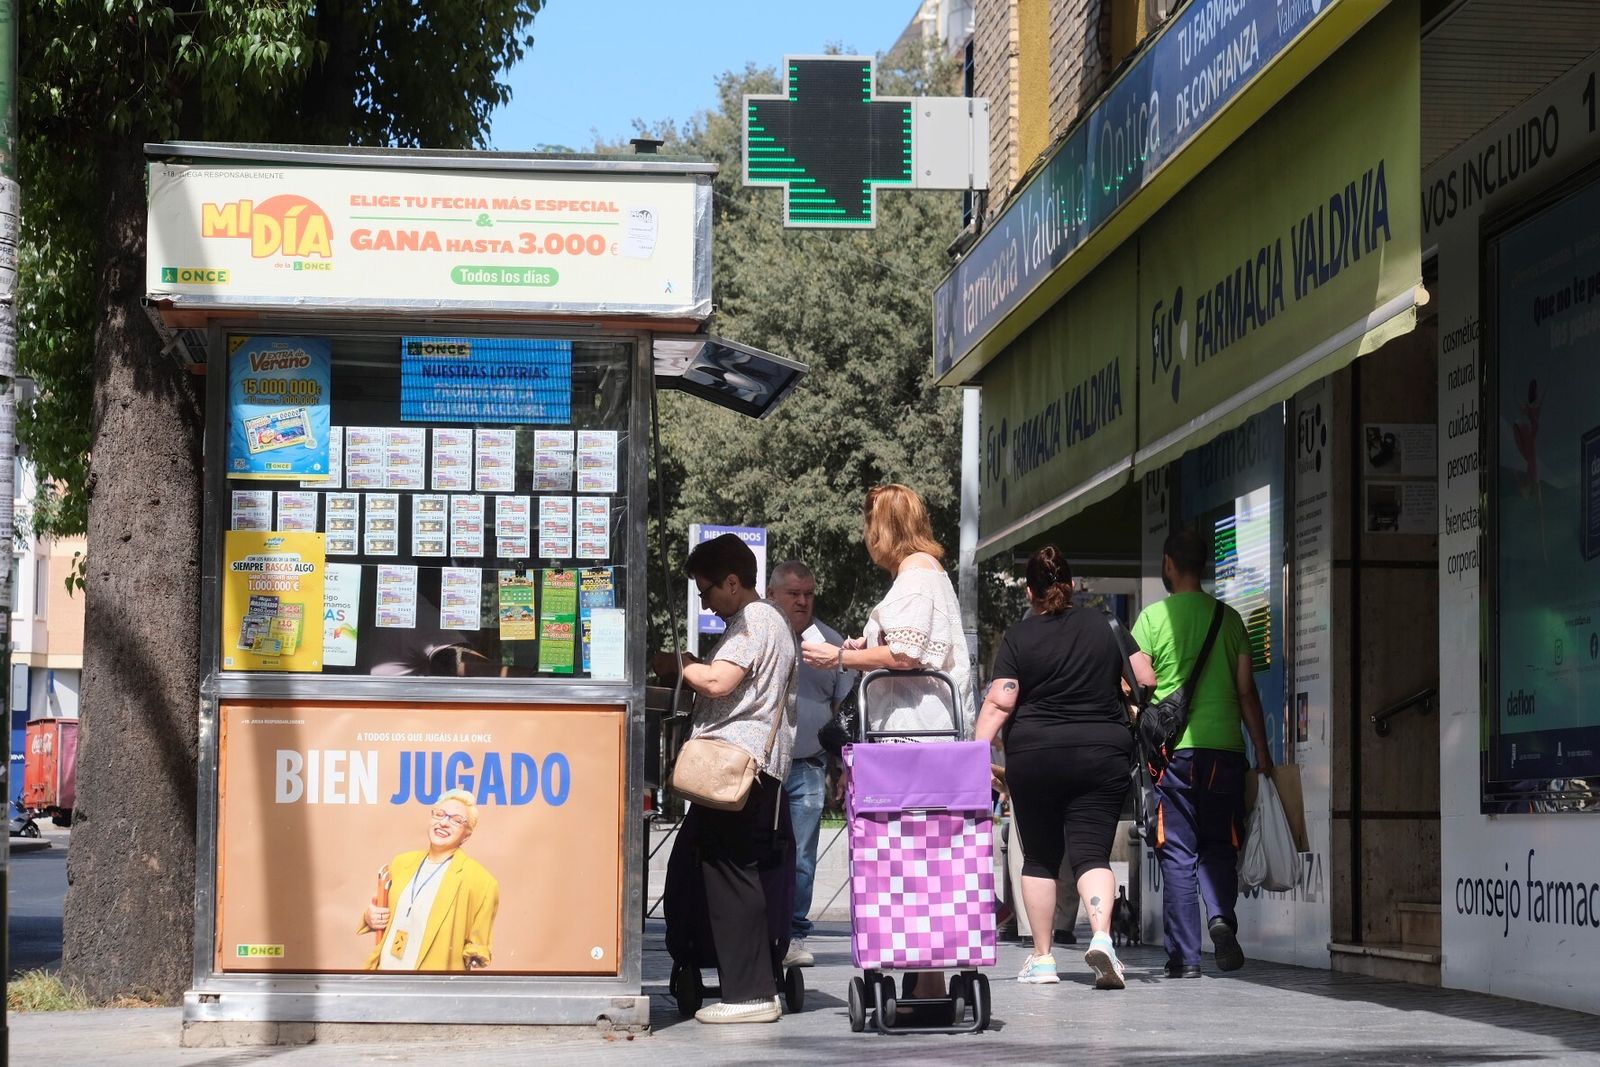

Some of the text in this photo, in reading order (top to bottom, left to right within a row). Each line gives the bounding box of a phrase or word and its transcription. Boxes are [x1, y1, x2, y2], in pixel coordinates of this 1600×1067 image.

[1177, 26, 1191, 70] TU
[1175, 20, 1260, 134] DE CONFIANZA
[1462, 105, 1559, 210] INCLUIDO
[204, 171, 284, 179] RESPONSABLEMENTE
[202, 199, 254, 238] MI
[349, 195, 620, 213] ELIGE TU FECHA MÁS ESPECIAL
[250, 204, 333, 259] DÍA
[349, 228, 443, 252] GANA
[446, 238, 515, 254] HASTA
[518, 232, 606, 256] 3.000
[181, 269, 227, 283] ONCE
[303, 262, 331, 271] ONCE
[459, 268, 550, 285] Todos los días
[1195, 159, 1392, 368] FARMACIA VALDIVIA
[962, 235, 1018, 337] farmacia
[425, 344, 467, 356] ONCE
[1442, 316, 1480, 355] cosmética
[249, 352, 311, 372] Verano
[1447, 350, 1476, 391] natural
[1012, 356, 1123, 483] FARMACIA VALDIVIA
[1447, 402, 1480, 440] cuidado
[232, 562, 315, 573] SIEMPRE RASCAS ALGO
[249, 581, 300, 591] 1.000.000 €
[1507, 688, 1536, 717] daflon
[356, 732, 363, 742] A
[363, 732, 390, 742] TODOS
[391, 732, 406, 742] LOS
[407, 732, 424, 743] QUE
[452, 733, 459, 743] A
[460, 733, 470, 743] LA
[471, 733, 493, 743] ONCE
[275, 749, 571, 807] BIEN JUGADO
[1455, 862, 1521, 938] consejo
[250, 946, 281, 956] ONCE
